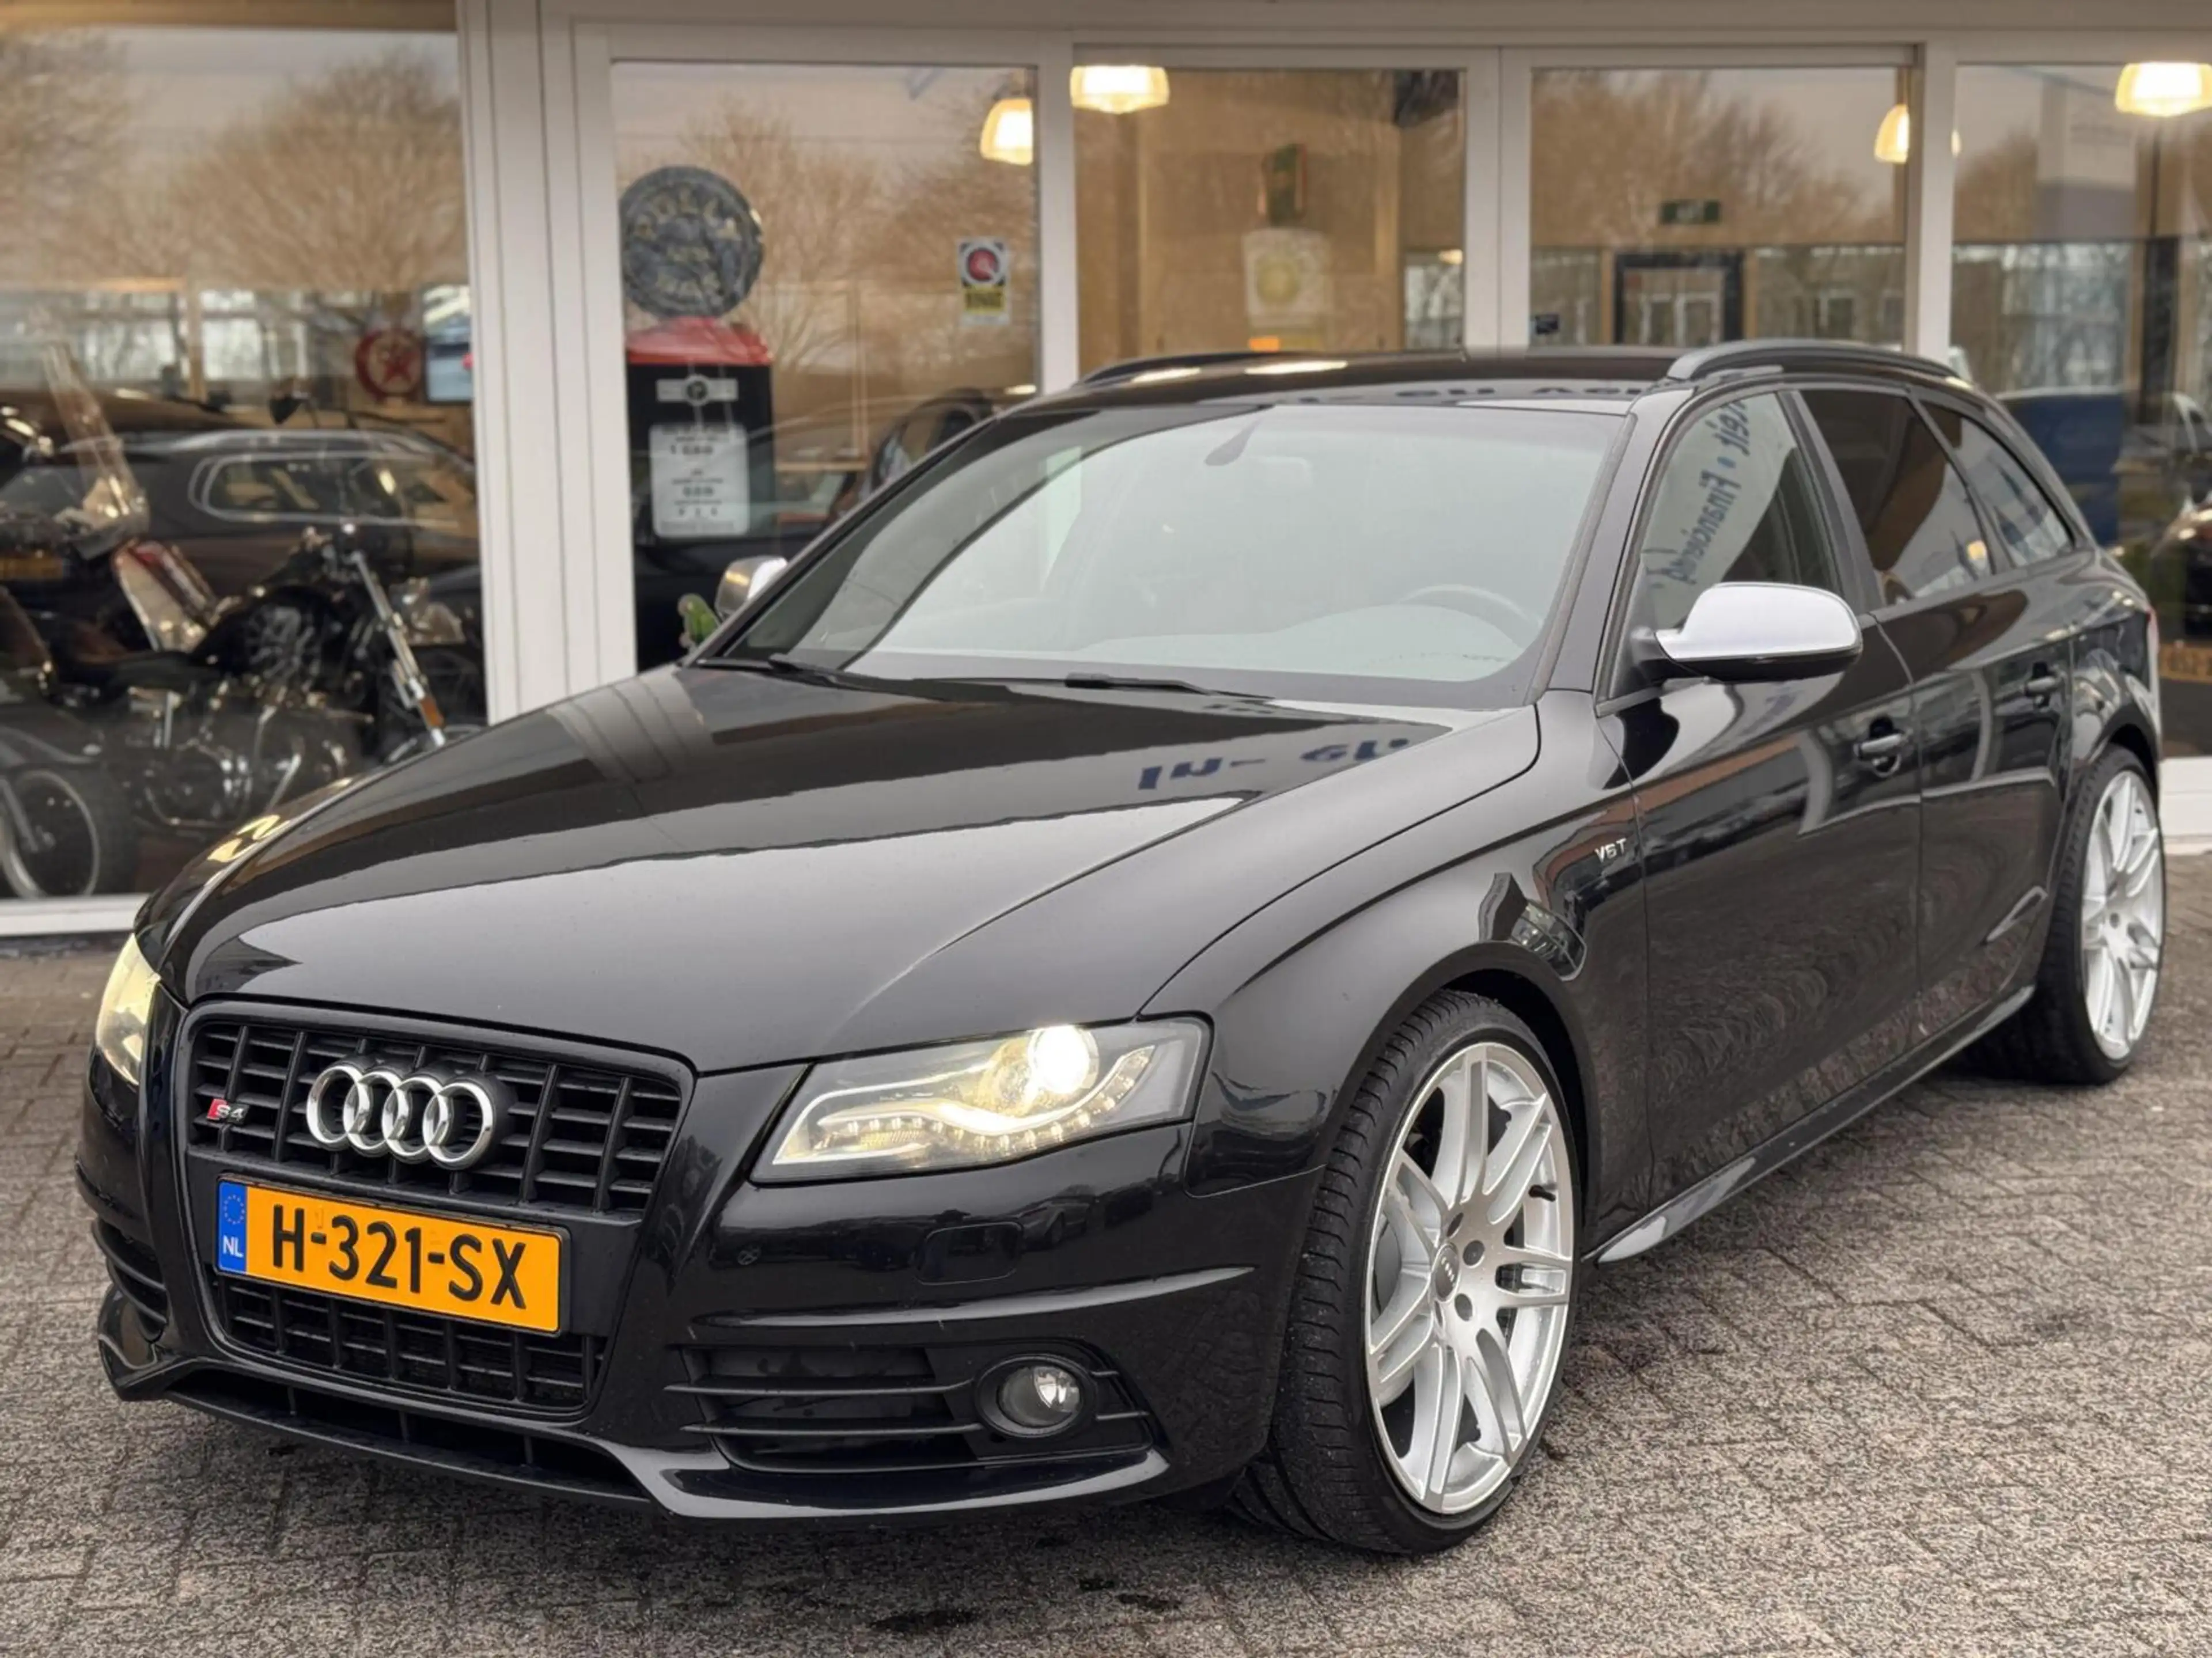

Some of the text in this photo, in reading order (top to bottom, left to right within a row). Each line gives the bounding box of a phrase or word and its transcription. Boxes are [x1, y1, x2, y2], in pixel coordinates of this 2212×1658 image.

[1594, 837, 1627, 863] V6T
[215, 1104, 244, 1122] S4
[222, 1203, 527, 1310] NL H-321-SX
